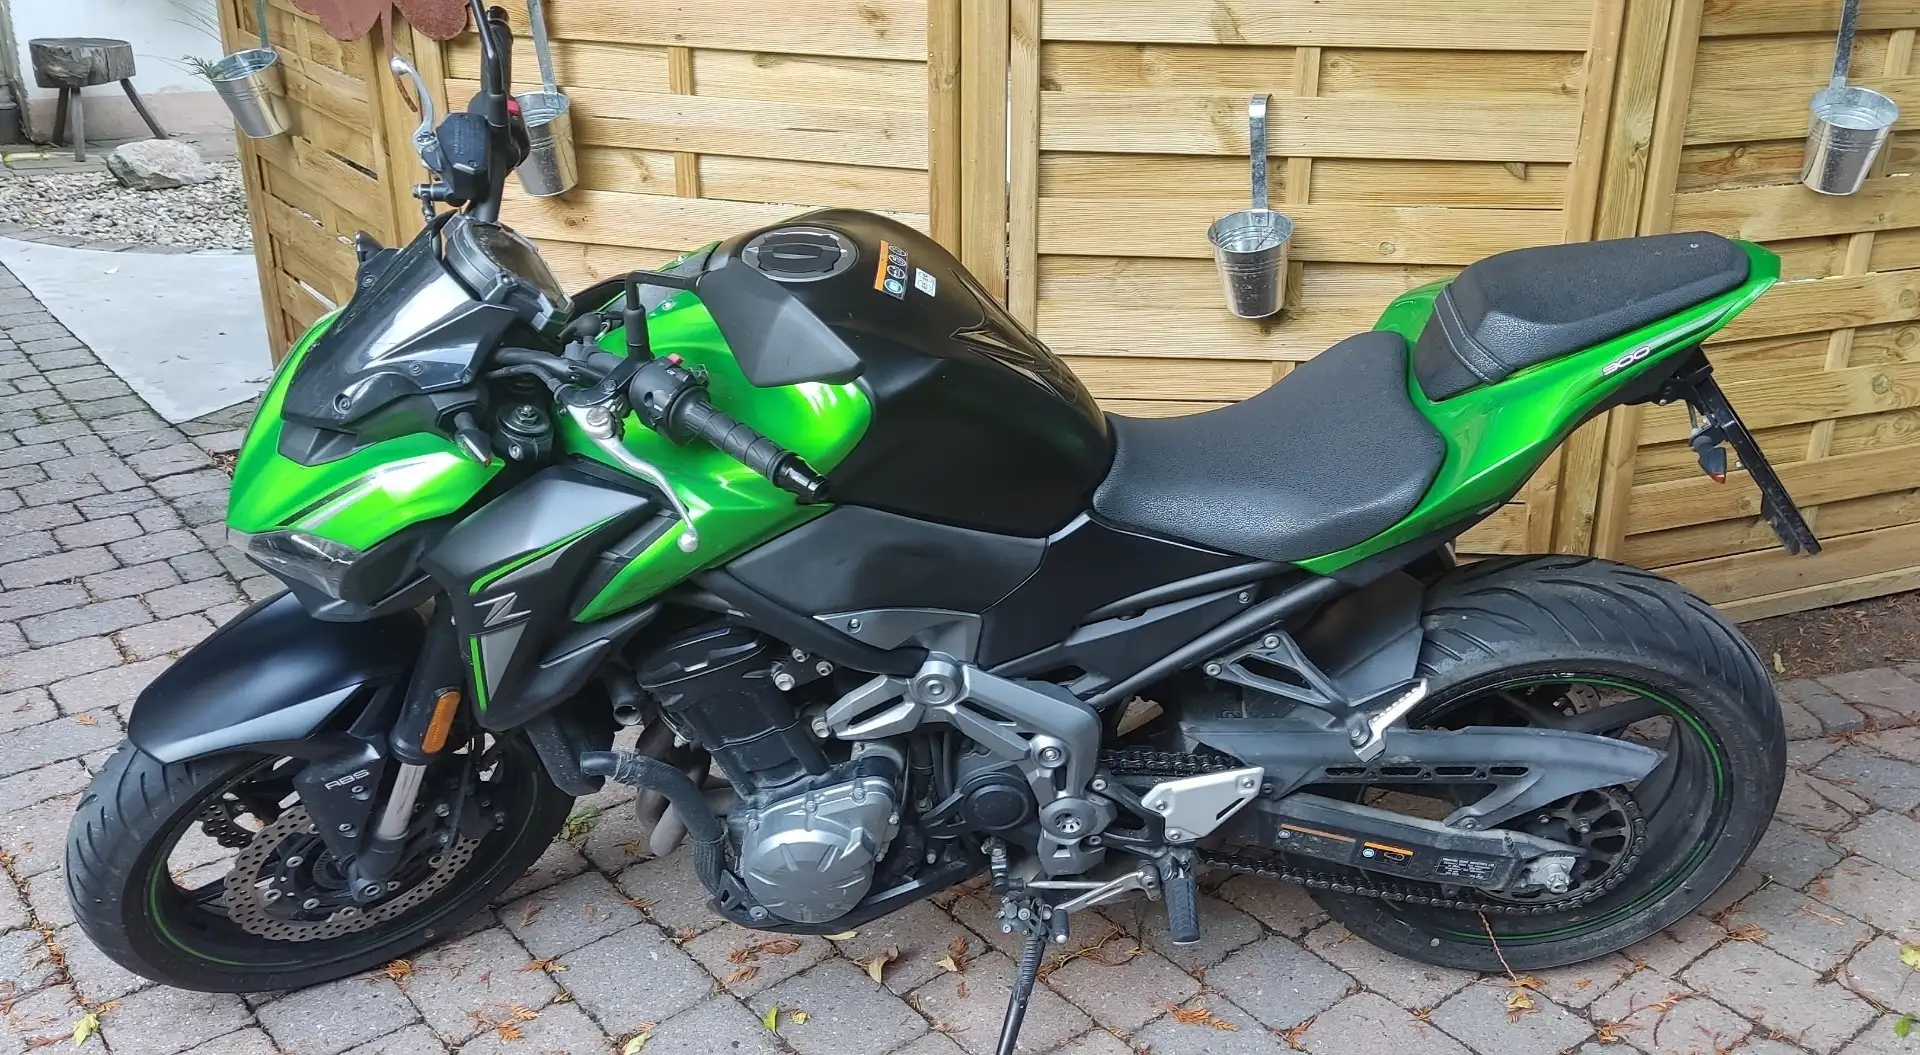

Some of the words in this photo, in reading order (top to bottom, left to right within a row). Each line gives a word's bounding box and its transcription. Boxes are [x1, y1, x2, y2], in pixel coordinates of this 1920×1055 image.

[1602, 346, 1650, 376] 900
[473, 591, 532, 628] Z
[324, 769, 370, 790] ABS
